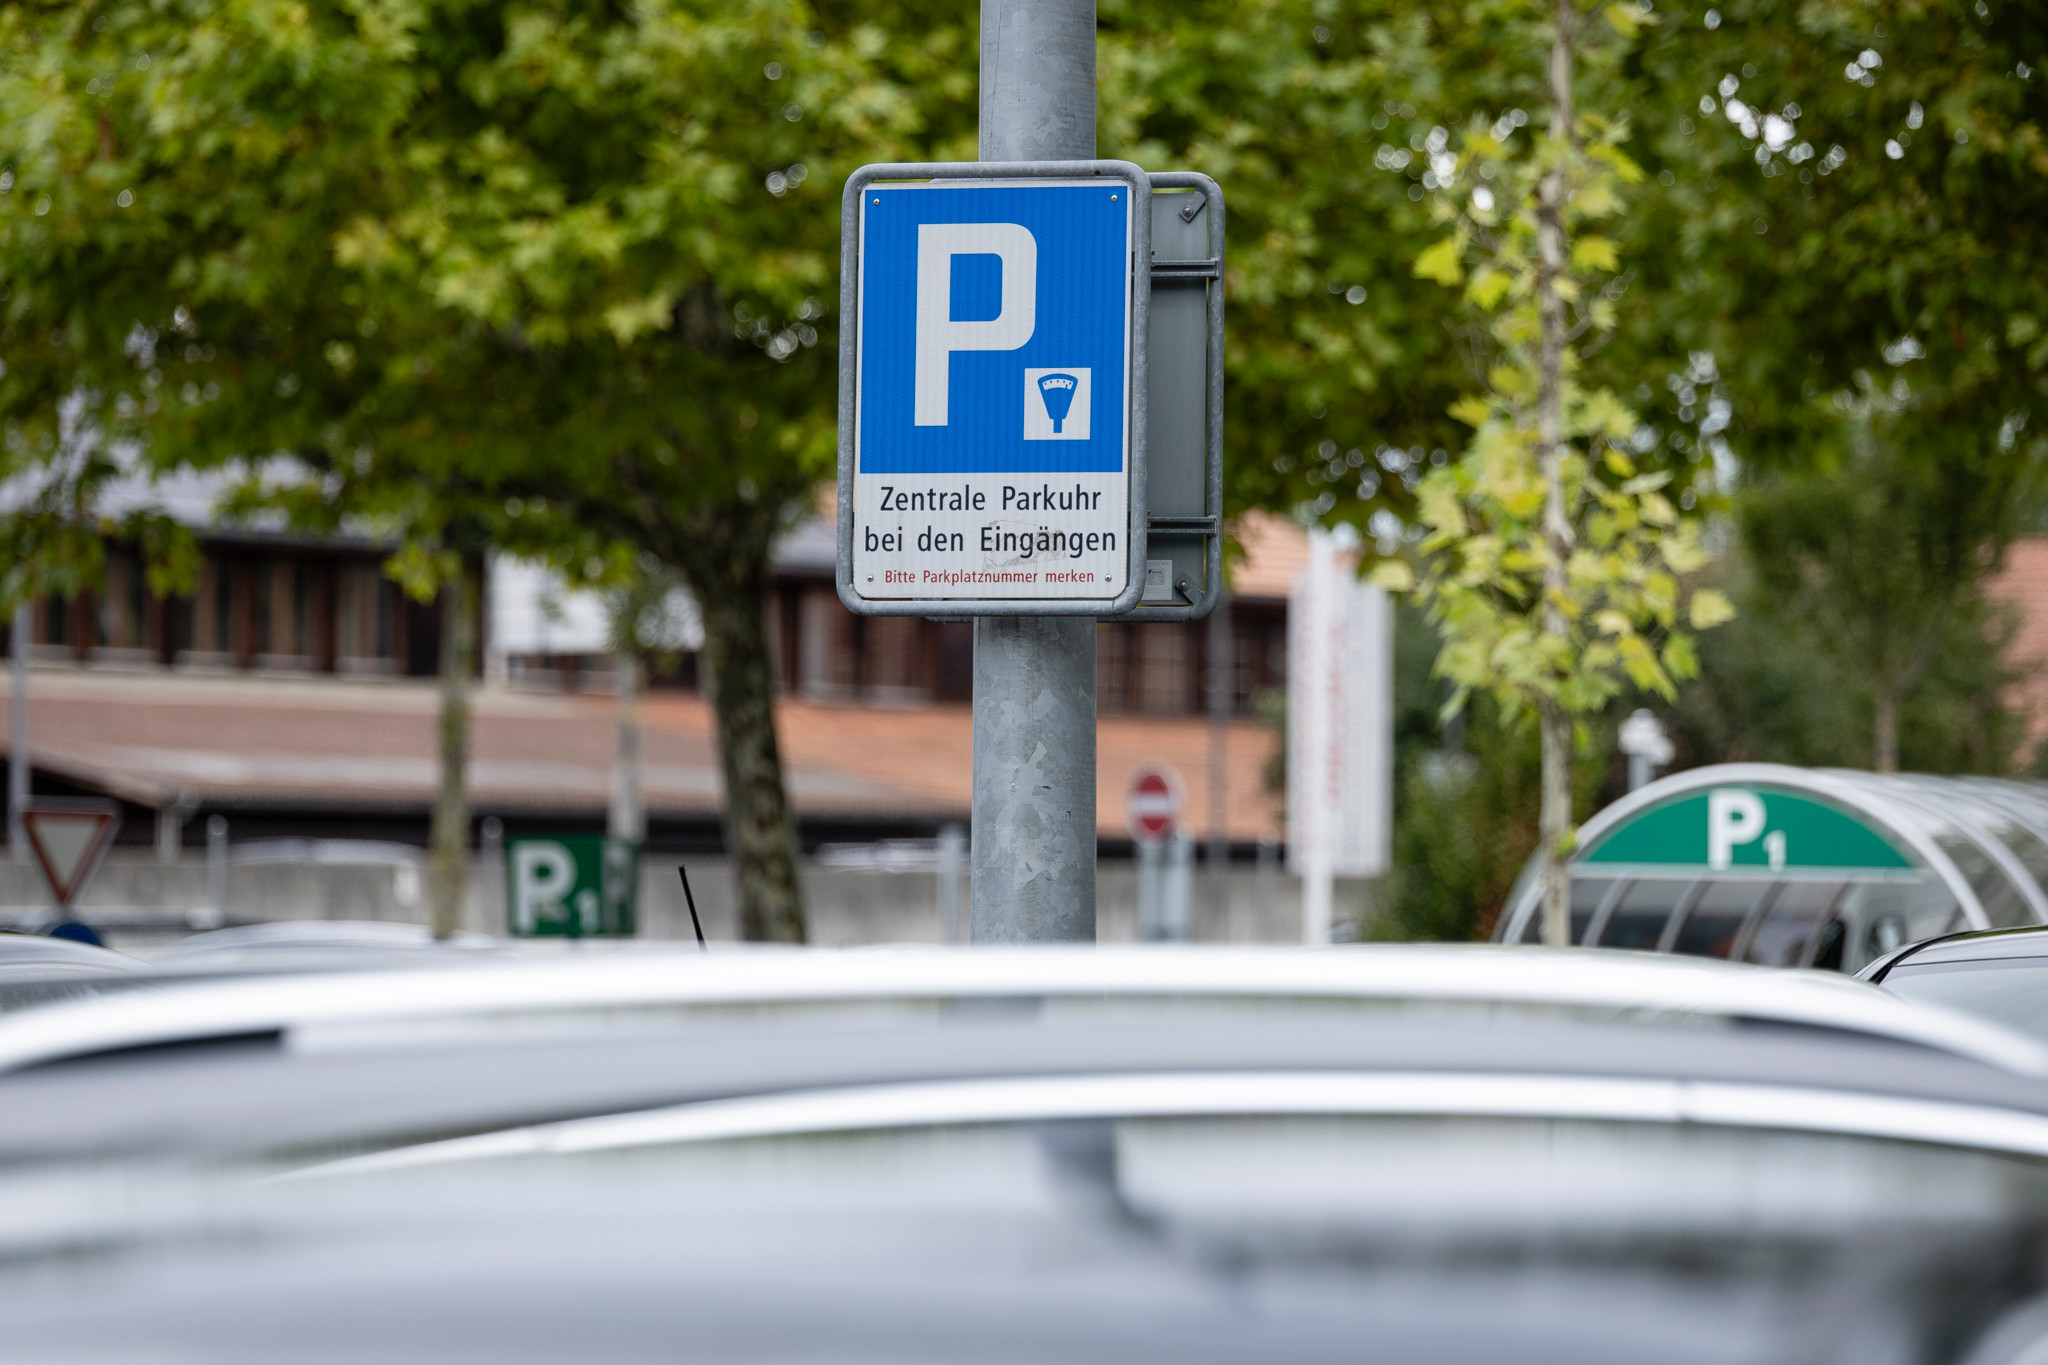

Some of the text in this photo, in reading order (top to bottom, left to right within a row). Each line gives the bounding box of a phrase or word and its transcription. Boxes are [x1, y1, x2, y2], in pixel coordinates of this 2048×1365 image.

[914, 222, 1037, 427] P
[880, 484, 1102, 511] Zentrale Parkuhr
[864, 526, 1117, 559] bei den Eingängen
[884, 568, 1094, 587] Bitte Parkplatznummer merken
